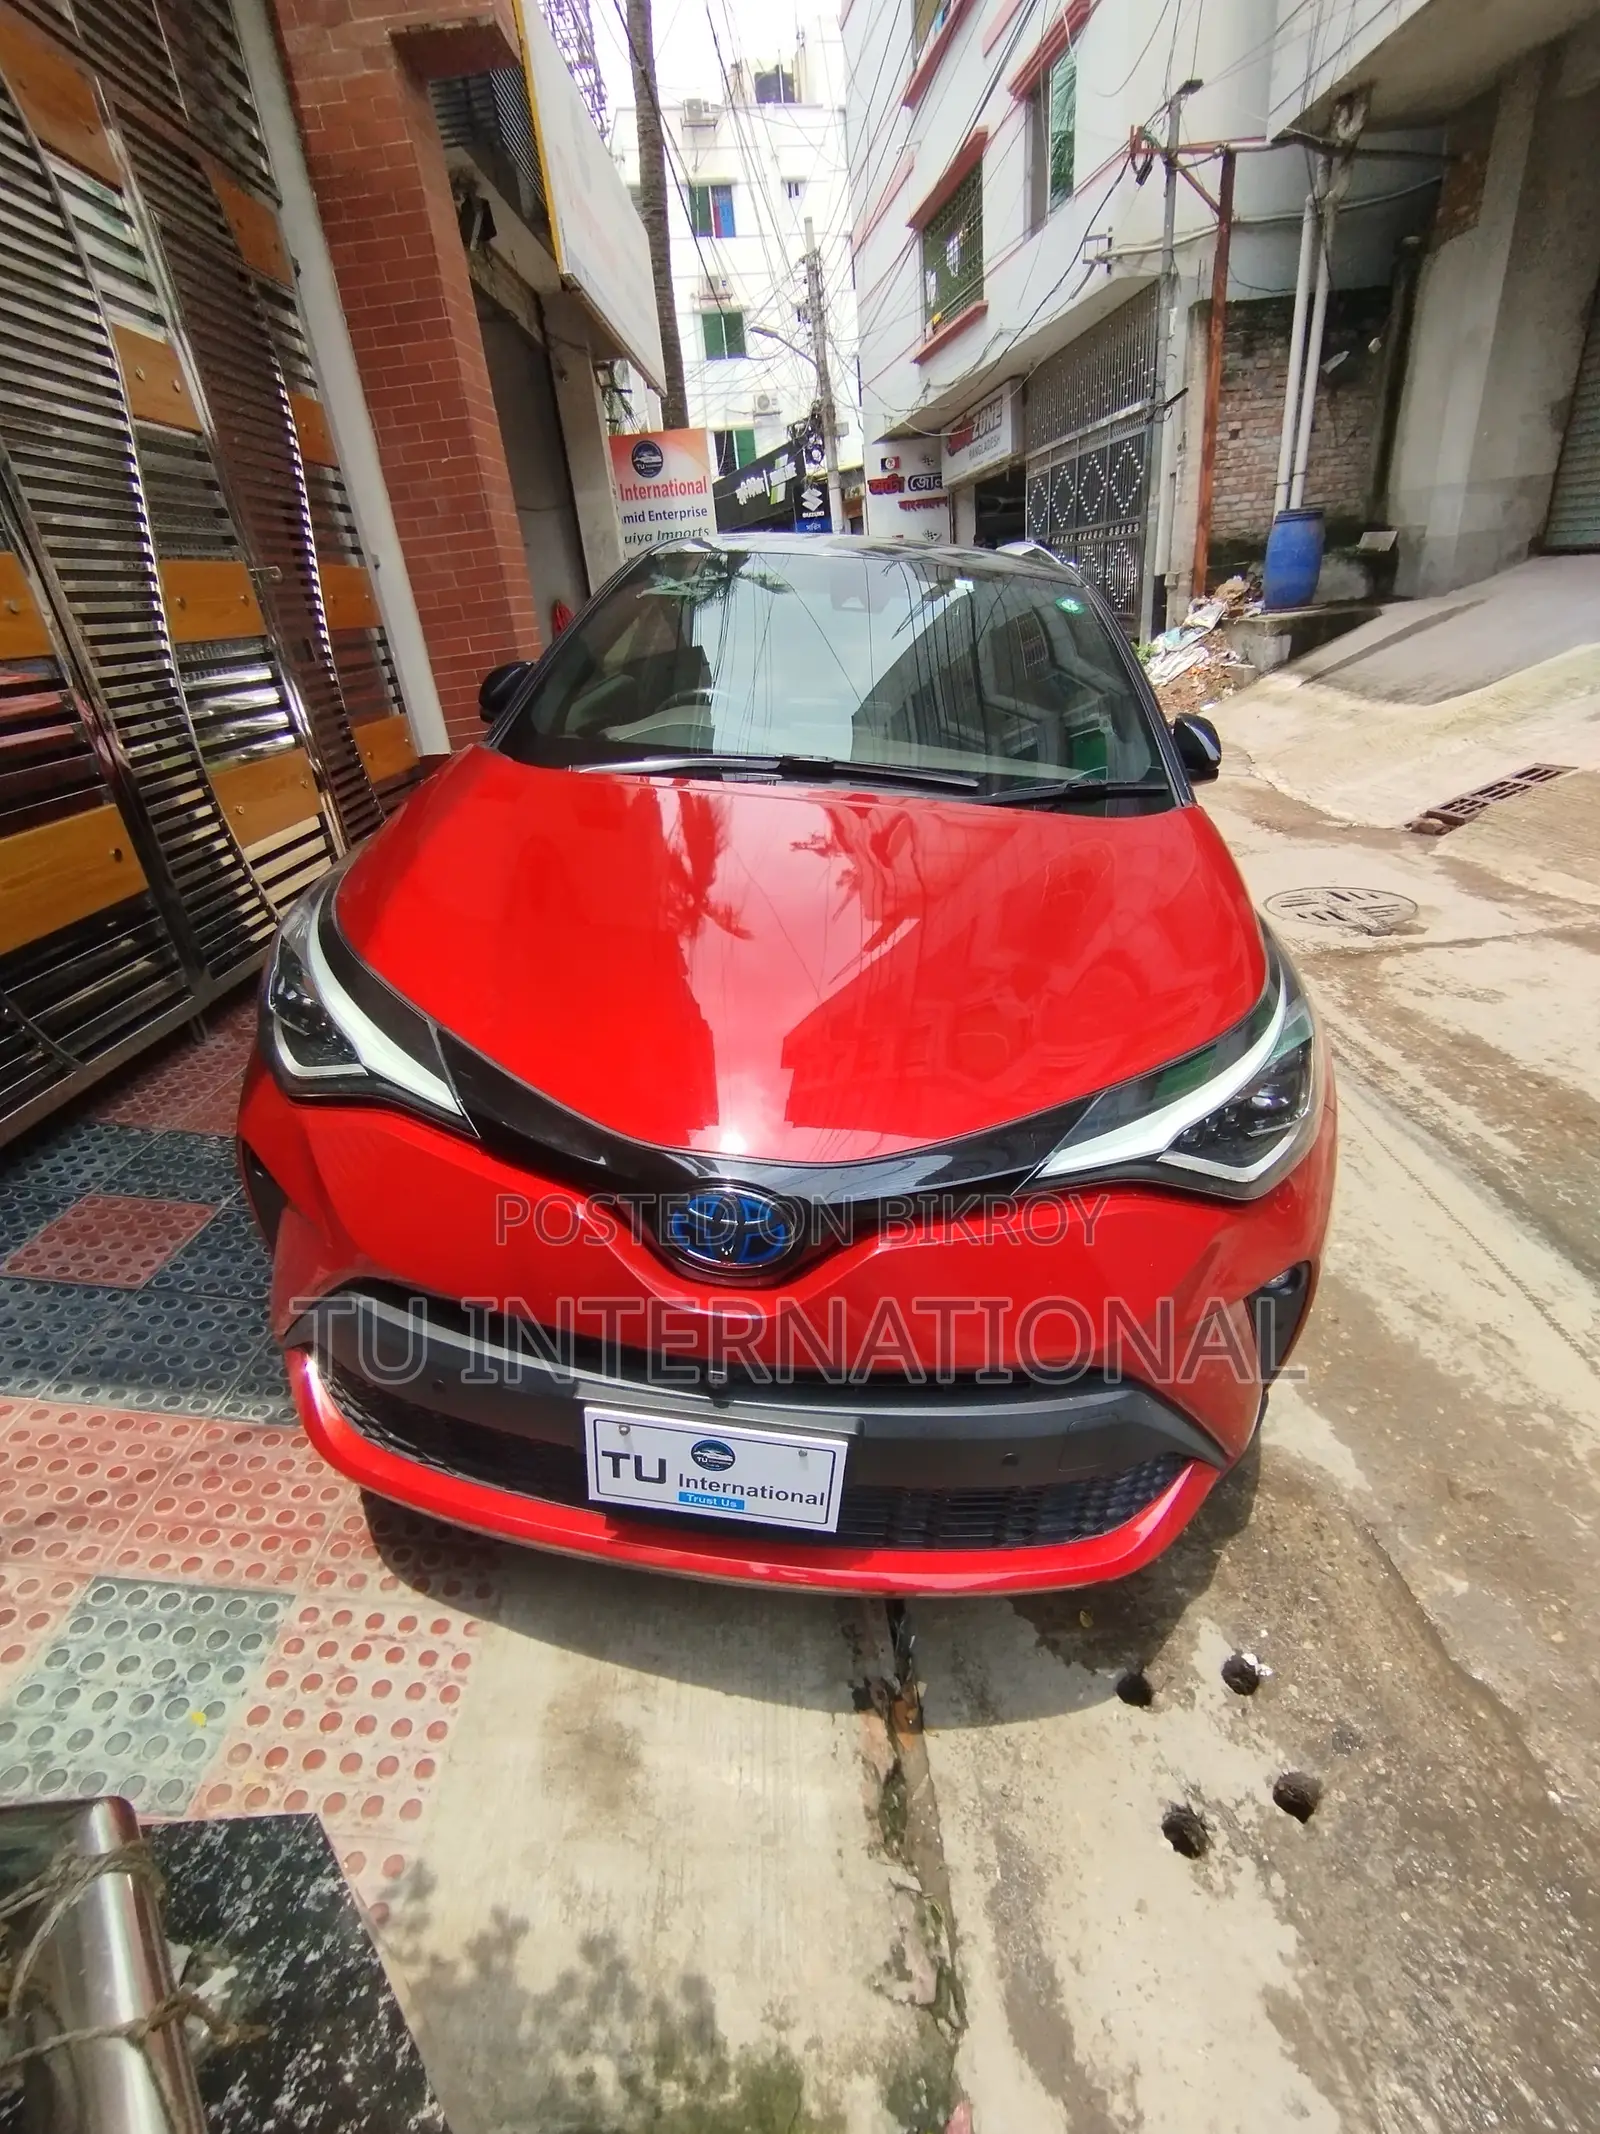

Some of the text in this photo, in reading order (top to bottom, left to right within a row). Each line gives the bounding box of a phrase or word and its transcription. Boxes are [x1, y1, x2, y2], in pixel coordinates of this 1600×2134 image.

[620, 476, 707, 501] International
[621, 506, 708, 525] mid Enterprise
[601, 1451, 825, 1506] TU International
[687, 1493, 737, 1508] Trust Us
